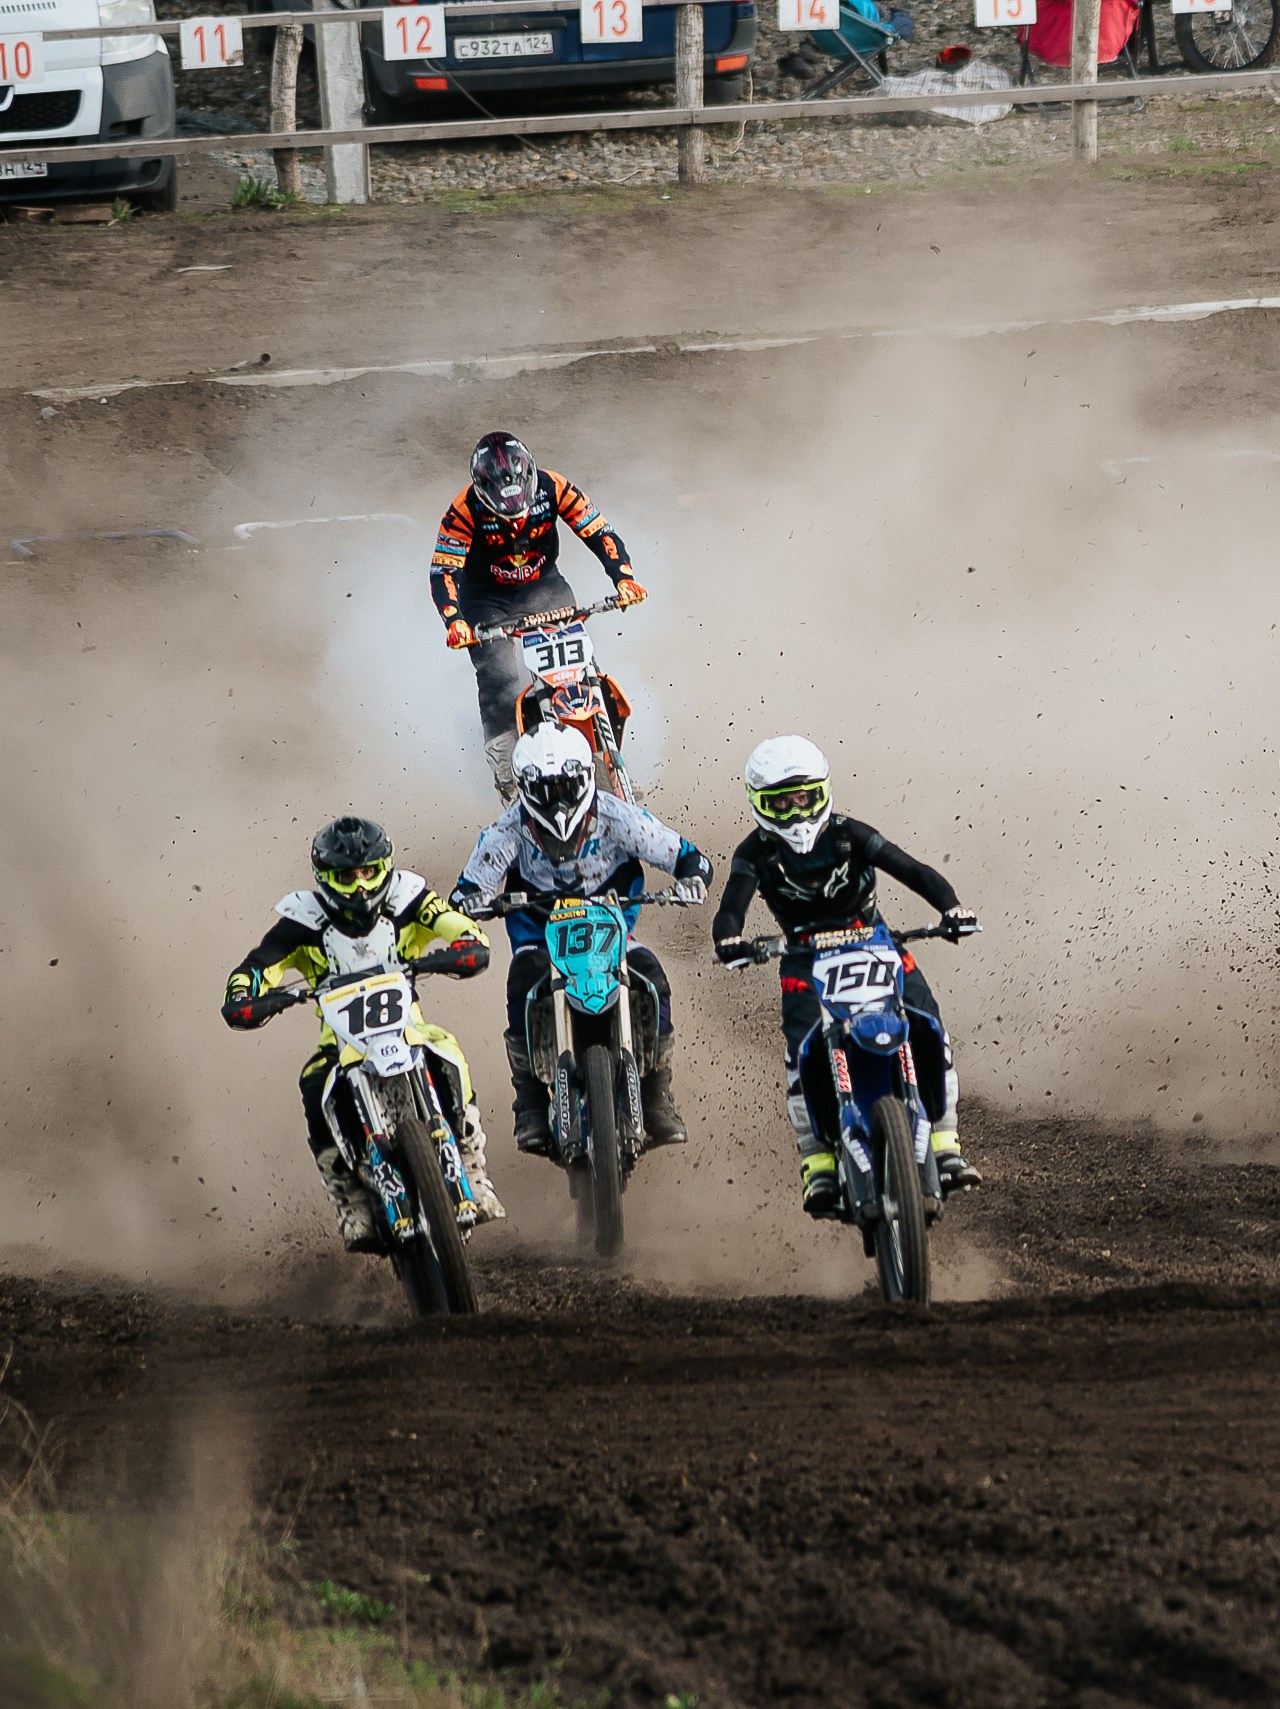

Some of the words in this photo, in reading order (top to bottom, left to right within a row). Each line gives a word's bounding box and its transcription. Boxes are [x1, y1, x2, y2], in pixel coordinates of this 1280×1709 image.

[396, 16, 432, 54] 12
[593, 0, 629, 37] 13
[0, 41, 32, 80] 10
[194, 24, 228, 63] 11
[526, 36, 550, 50] 124
[536, 639, 585, 672] 313
[555, 922, 620, 960] 137
[825, 961, 896, 997] 150
[337, 988, 403, 1036] 18
